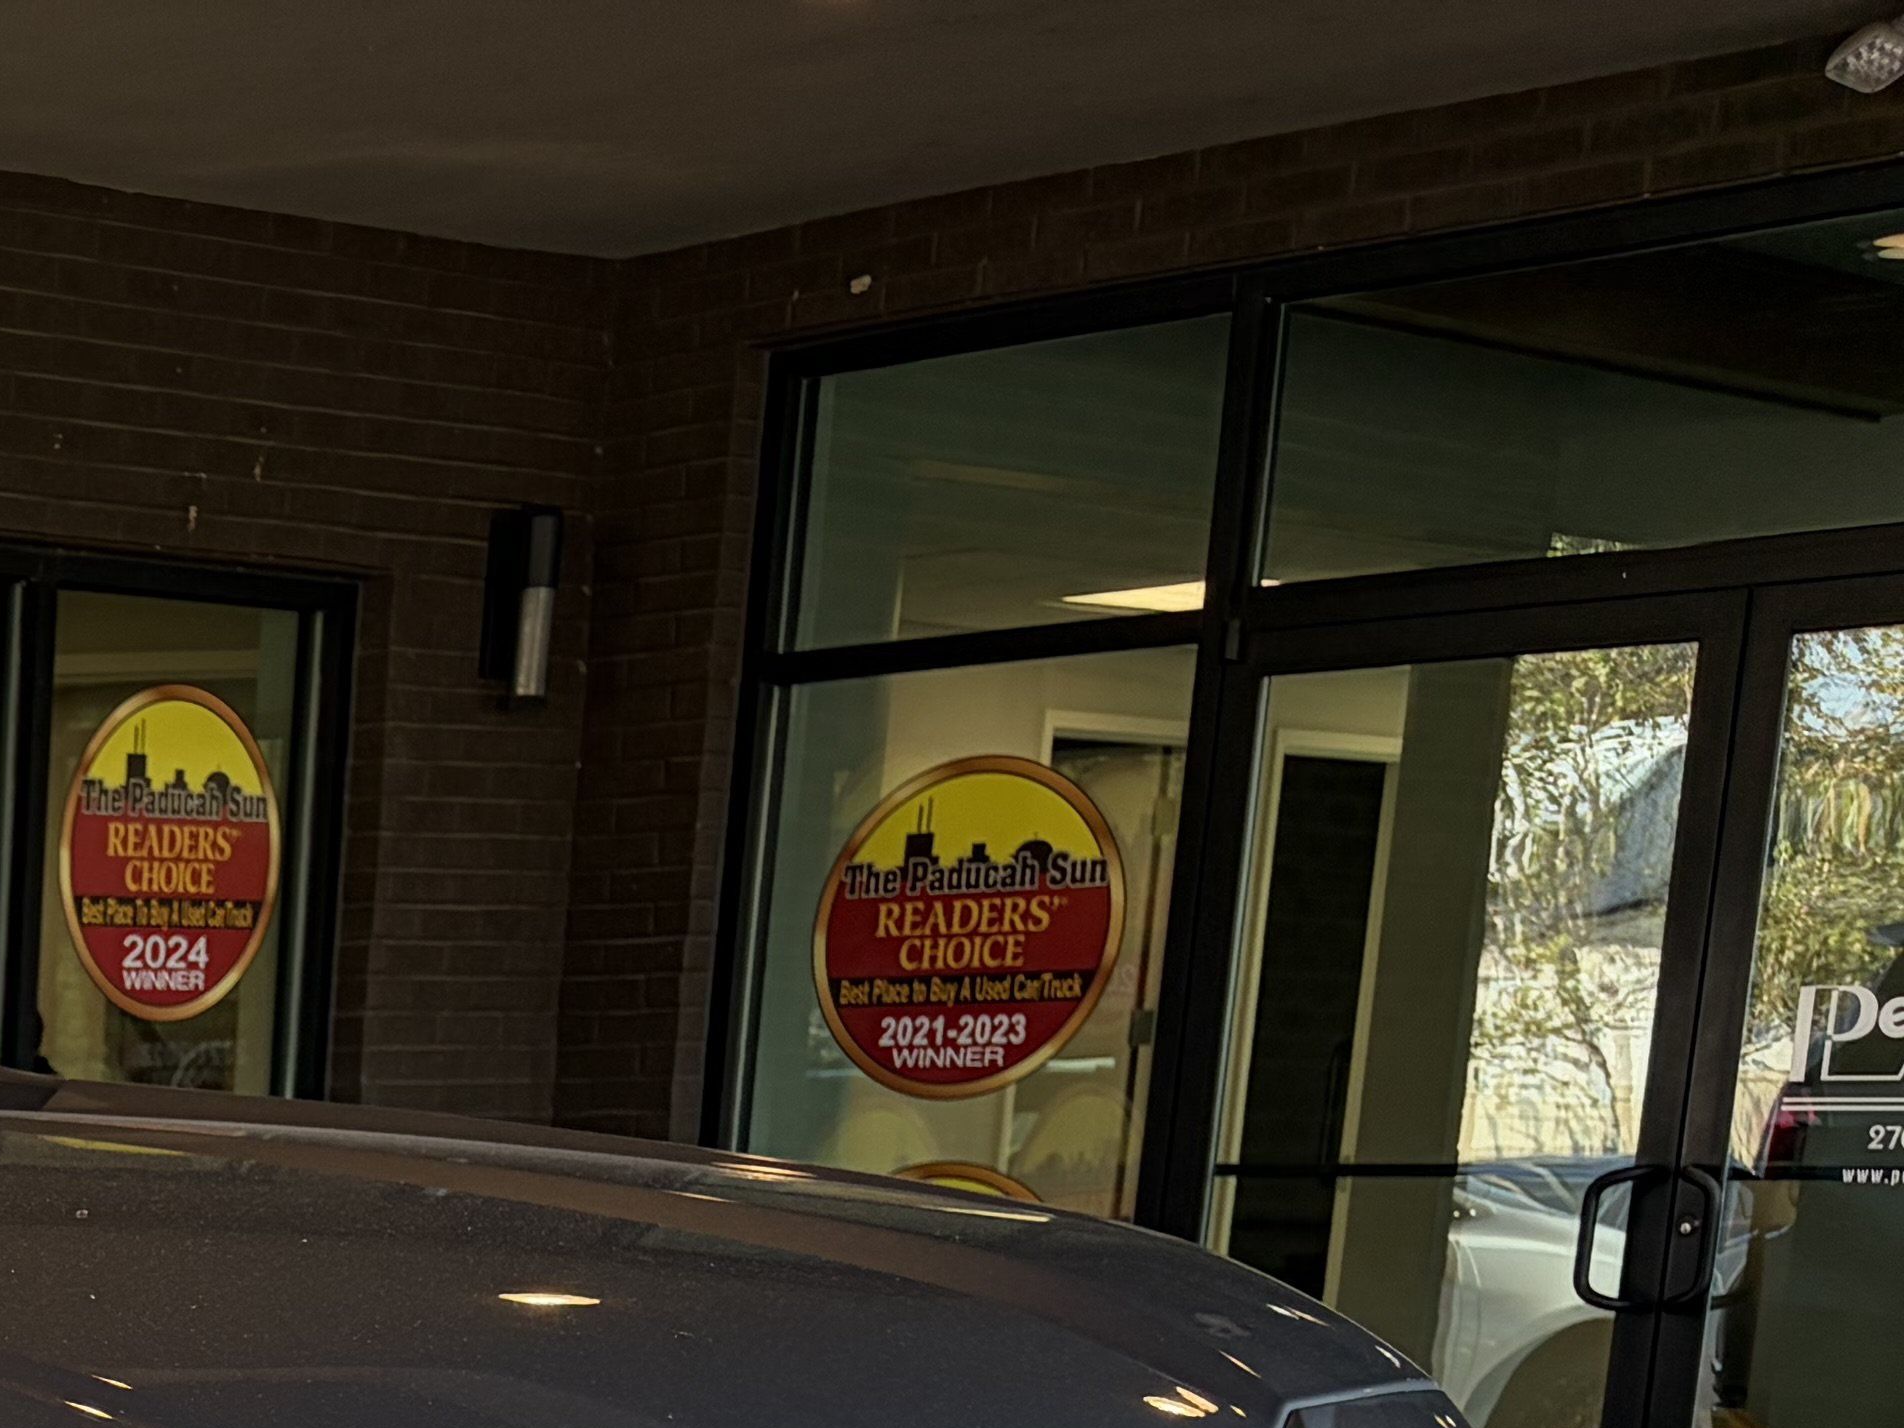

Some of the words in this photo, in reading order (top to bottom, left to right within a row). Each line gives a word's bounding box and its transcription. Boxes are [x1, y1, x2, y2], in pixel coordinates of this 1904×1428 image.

[81, 779, 123, 815] The
[128, 778, 222, 820] Paducah
[227, 786, 267, 823] Sun
[124, 860, 216, 895] CHOICE
[844, 862, 899, 899] The
[907, 851, 1039, 897] Paducah
[1047, 852, 1109, 890] Sun
[82, 897, 105, 924] Best
[122, 934, 209, 969] 2024
[898, 934, 1025, 971] CHOICE
[122, 969, 205, 991] WINNER
[839, 979, 869, 1004] Best
[872, 978, 909, 1003] Place
[930, 977, 958, 1007] Buy
[960, 976, 972, 1001] A
[974, 975, 1011, 1000] Used
[878, 1013, 1027, 1047] 2021-2023
[892, 1045, 1004, 1068] WINNER
[1867, 1124, 1904, 1150] 27
[1842, 1168, 1904, 1187] www.p
